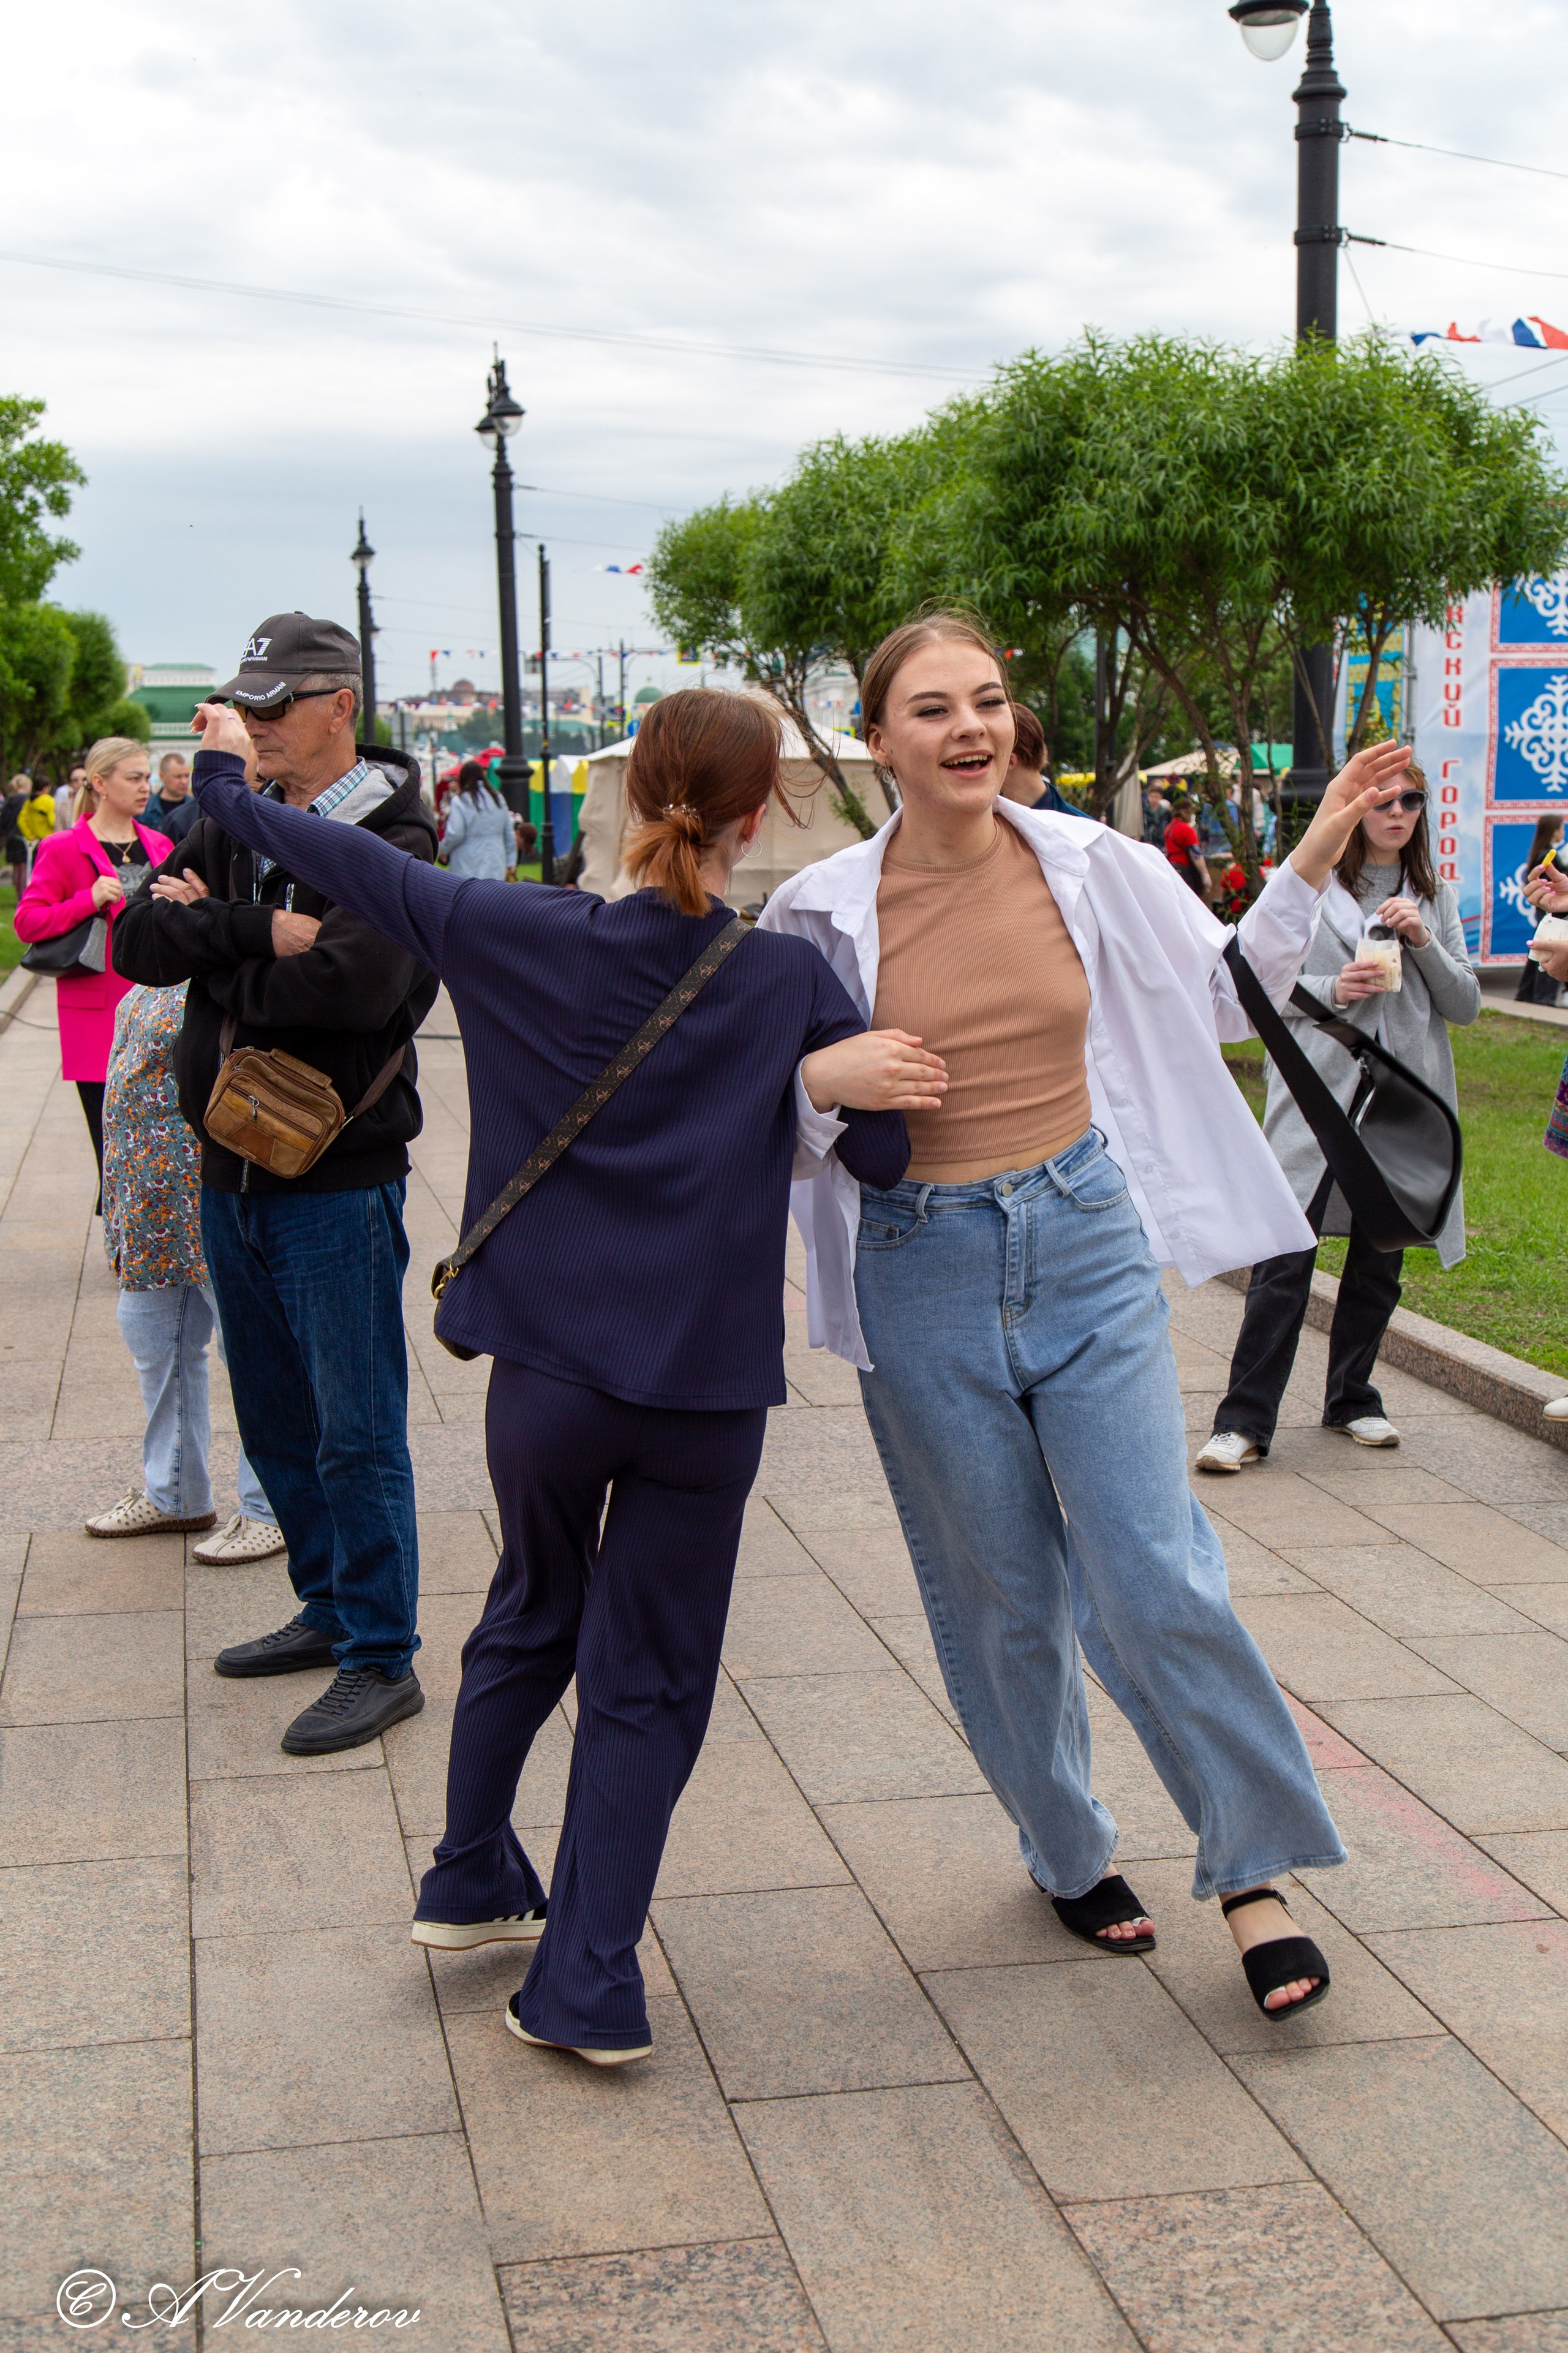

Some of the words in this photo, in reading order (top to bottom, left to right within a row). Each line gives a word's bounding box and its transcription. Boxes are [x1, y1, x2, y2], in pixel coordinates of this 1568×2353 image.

[235, 690, 266, 701] EMPORIO
[265, 681, 287, 699] ARMANI
[1439, 759, 1461, 896] ГОРОД
